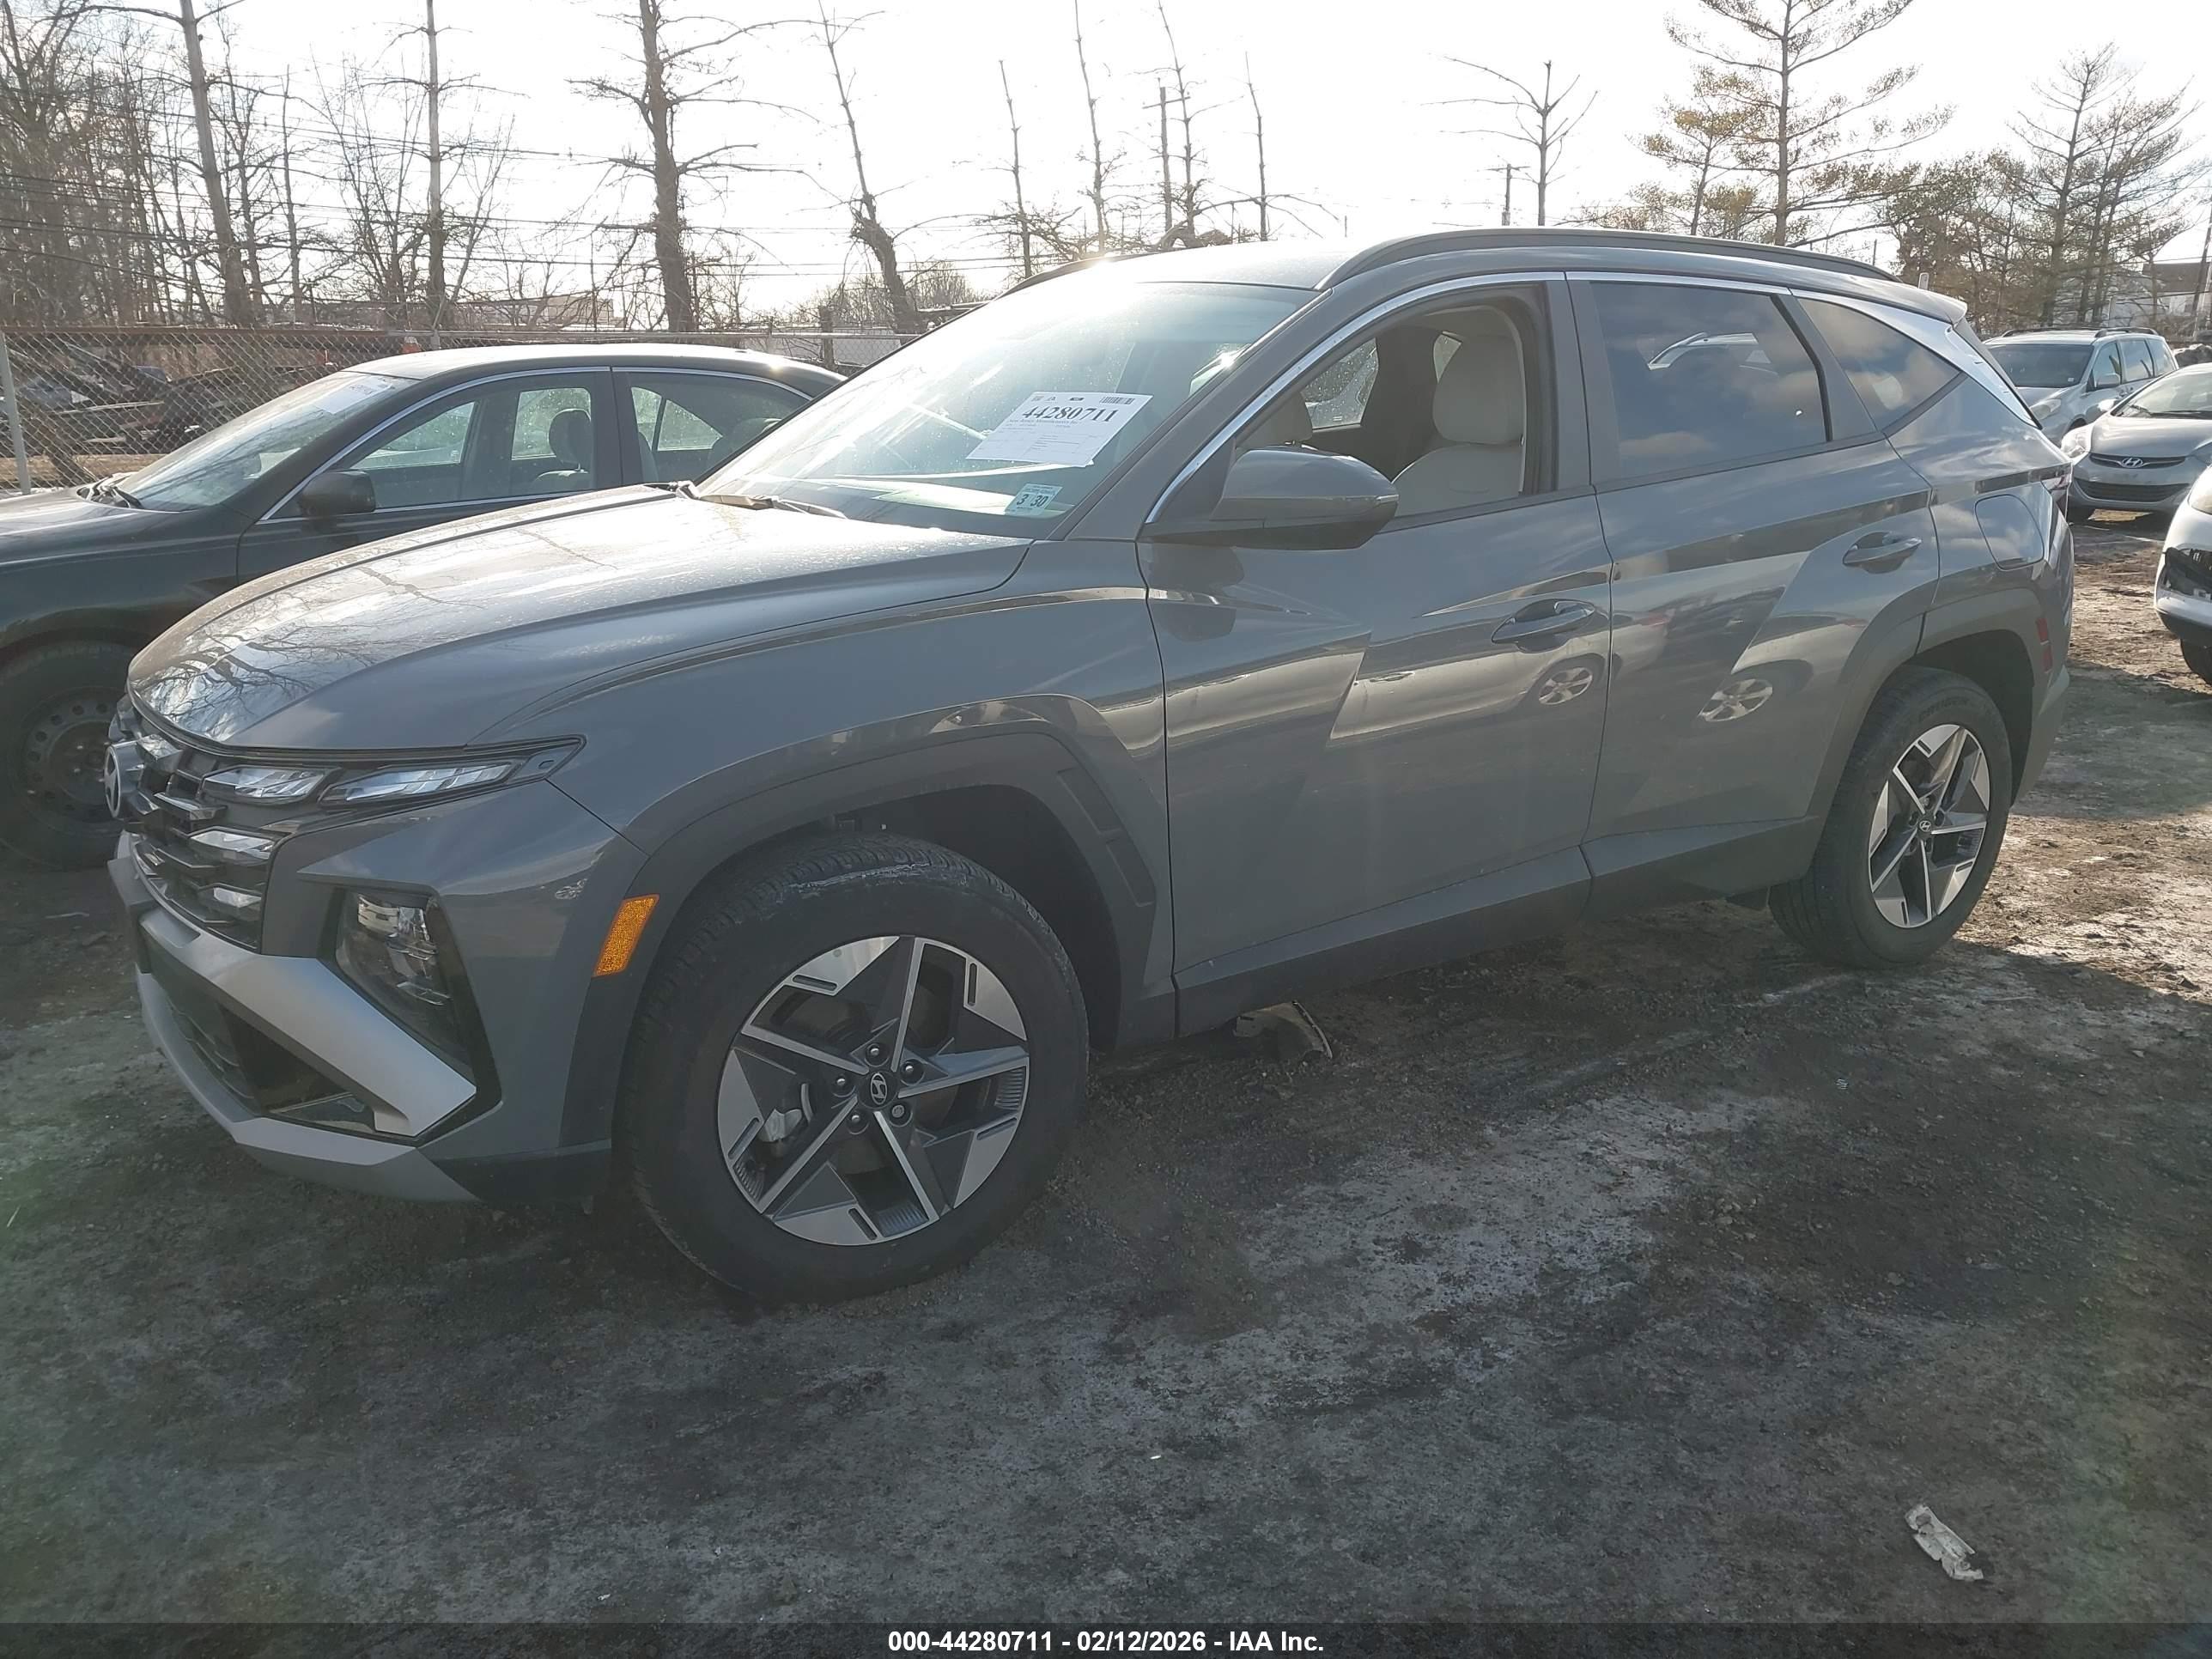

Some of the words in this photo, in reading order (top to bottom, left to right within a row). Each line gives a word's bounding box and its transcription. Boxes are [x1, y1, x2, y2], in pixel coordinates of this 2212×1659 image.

[1022, 405, 1120, 422] 44280711
[1016, 493, 1030, 506] 3
[1030, 495, 1049, 507] 30
